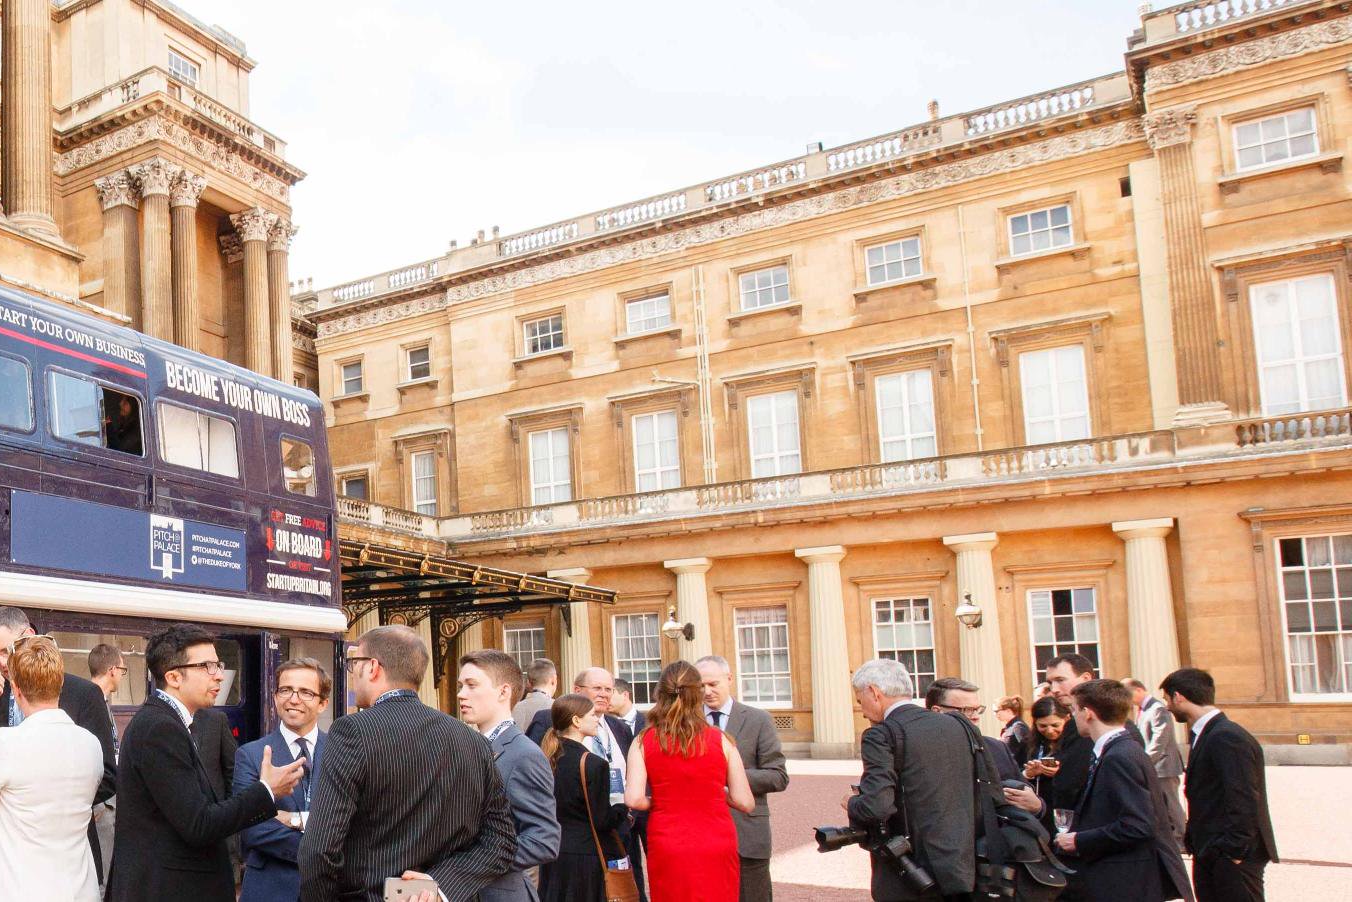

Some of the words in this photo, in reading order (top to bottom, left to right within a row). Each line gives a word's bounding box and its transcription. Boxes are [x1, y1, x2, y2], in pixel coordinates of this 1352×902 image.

[29, 316, 64, 340] YOUR
[65, 328, 94, 348] OWN
[165, 361, 220, 401] BECOME
[220, 378, 253, 411] YOUR
[254, 390, 281, 419] OWN
[282, 397, 311, 427] BOSS
[285, 513, 301, 526] FREE
[302, 518, 326, 531] ADVICE
[153, 529, 174, 542] PITCH
[153, 540, 180, 553] PALACE
[276, 529, 289, 552] ON
[291, 532, 322, 558] BOARD
[266, 572, 331, 597] STARTUPBRITAIN.ORG
